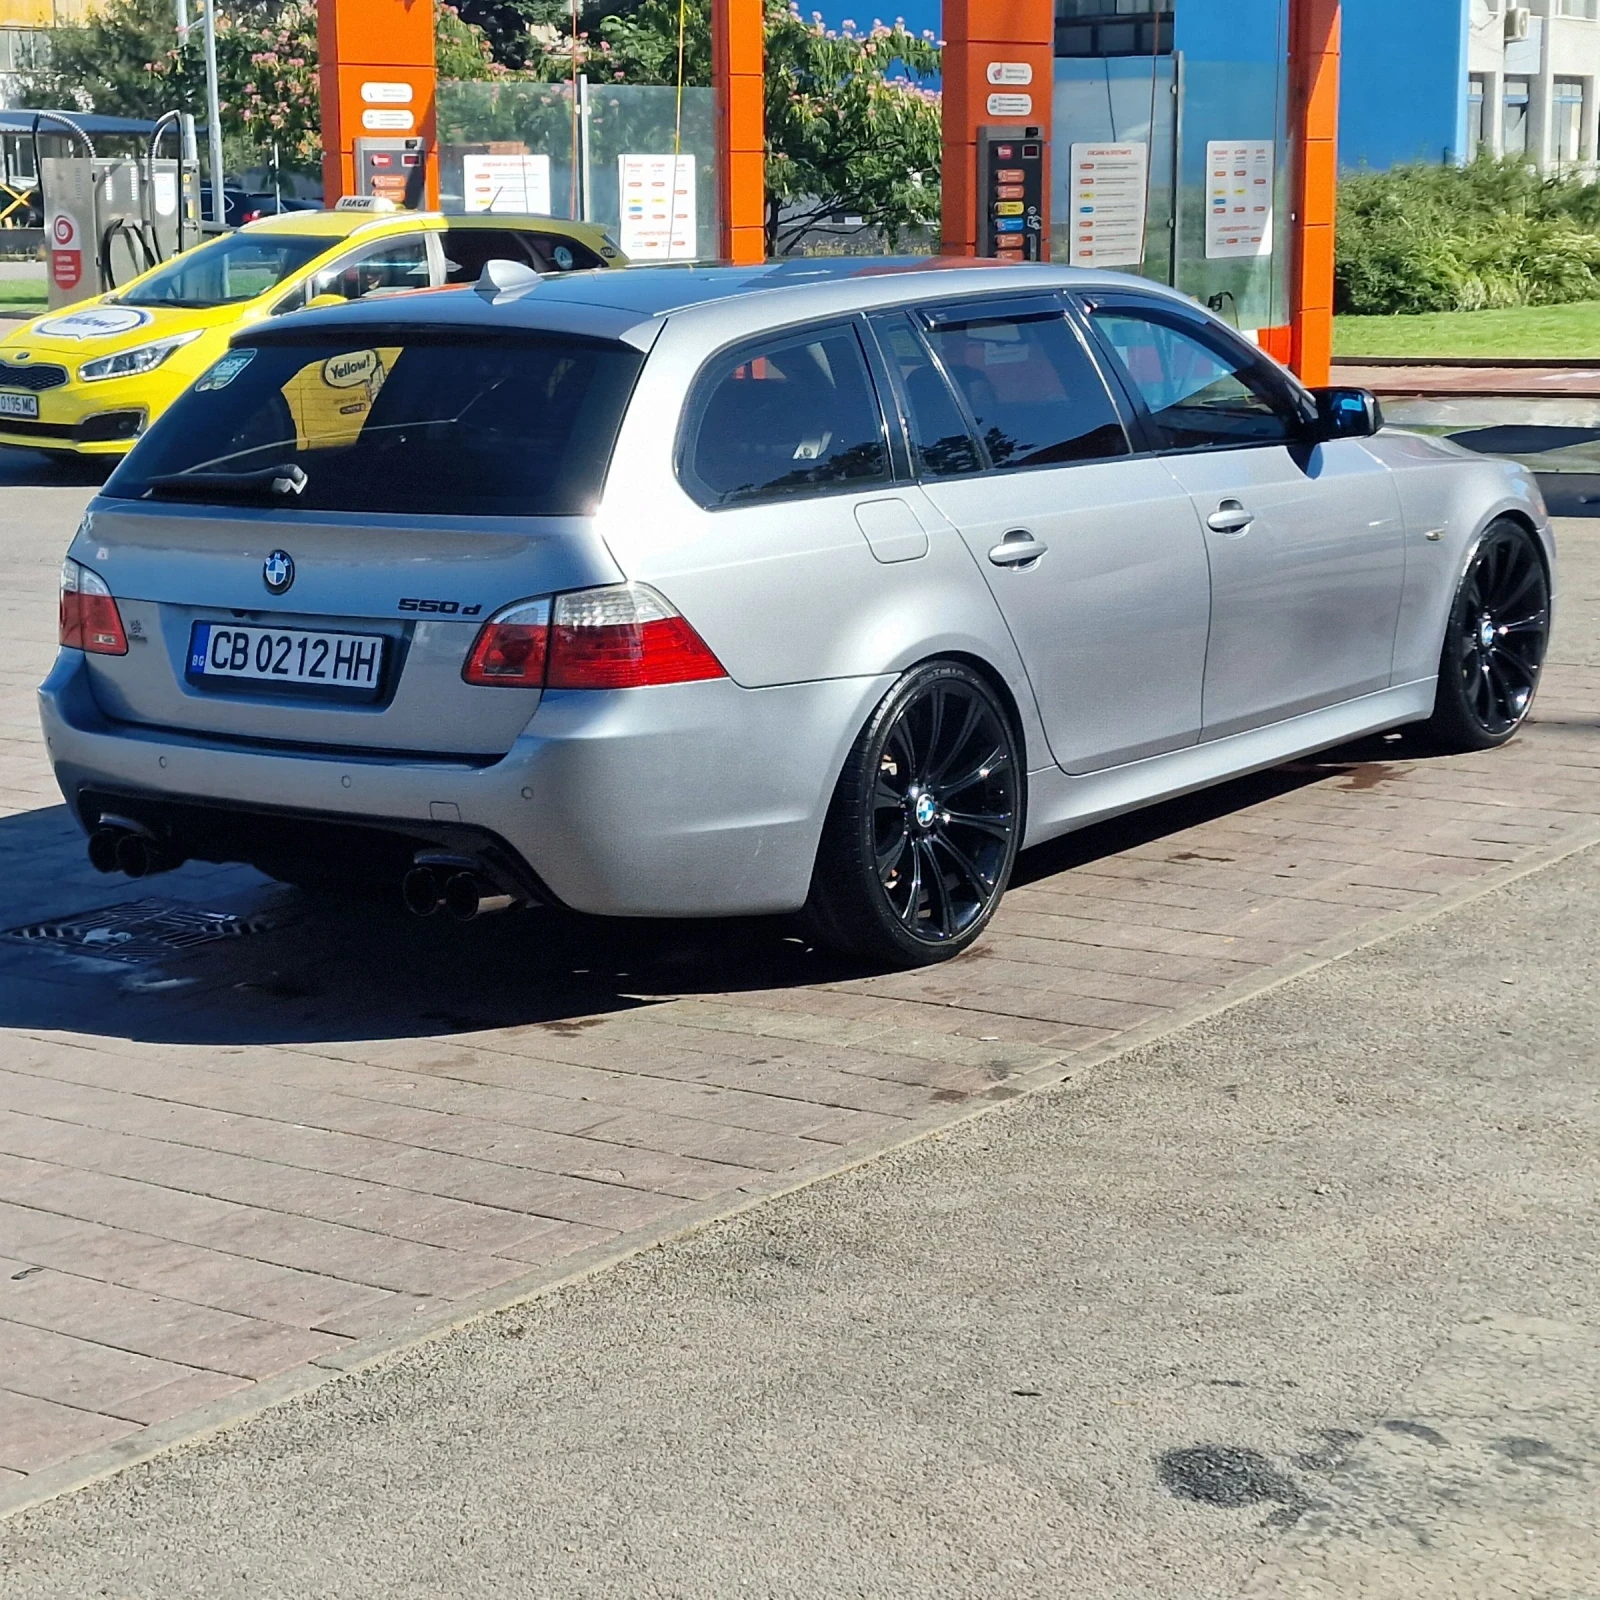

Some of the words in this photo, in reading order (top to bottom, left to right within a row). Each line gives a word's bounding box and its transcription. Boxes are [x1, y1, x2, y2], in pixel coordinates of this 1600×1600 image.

[342, 199, 370, 207] ТАКСИ
[331, 354, 370, 379] Yellow!
[192, 654, 204, 667] BG
[211, 631, 249, 670] CB
[256, 634, 329, 678] 0212
[332, 639, 376, 681] HH
